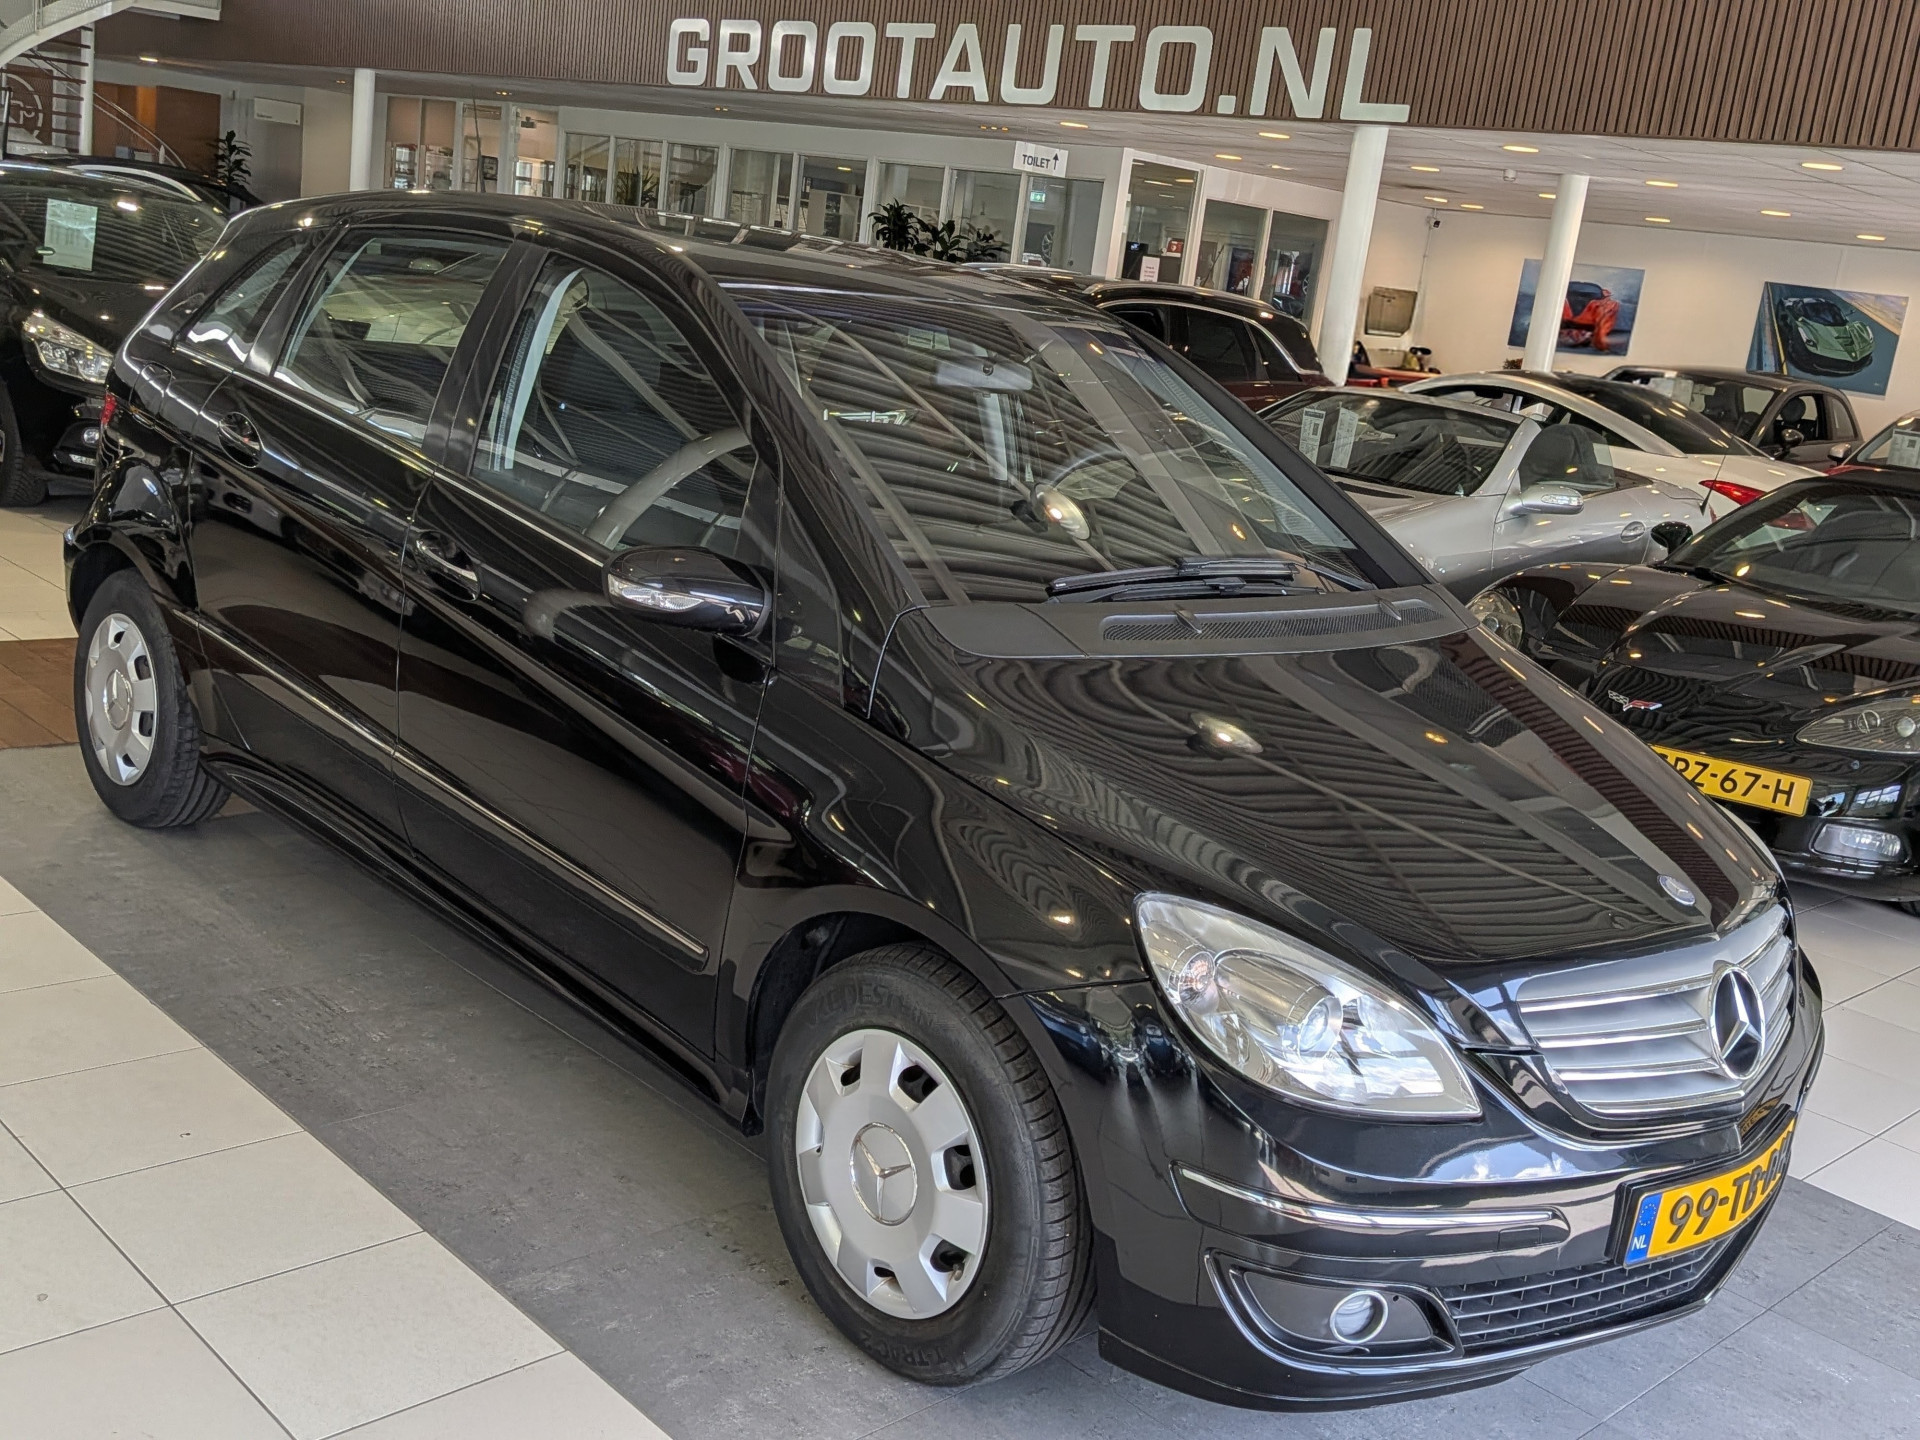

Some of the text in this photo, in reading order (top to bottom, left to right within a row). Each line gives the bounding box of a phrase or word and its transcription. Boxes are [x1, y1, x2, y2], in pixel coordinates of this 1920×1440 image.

[667, 18, 1409, 122] GROOTAUTO.NL
[1022, 154, 1051, 169] TOILET
[1657, 753, 1795, 807] RZ-67-H
[1631, 1234, 1647, 1251] NL
